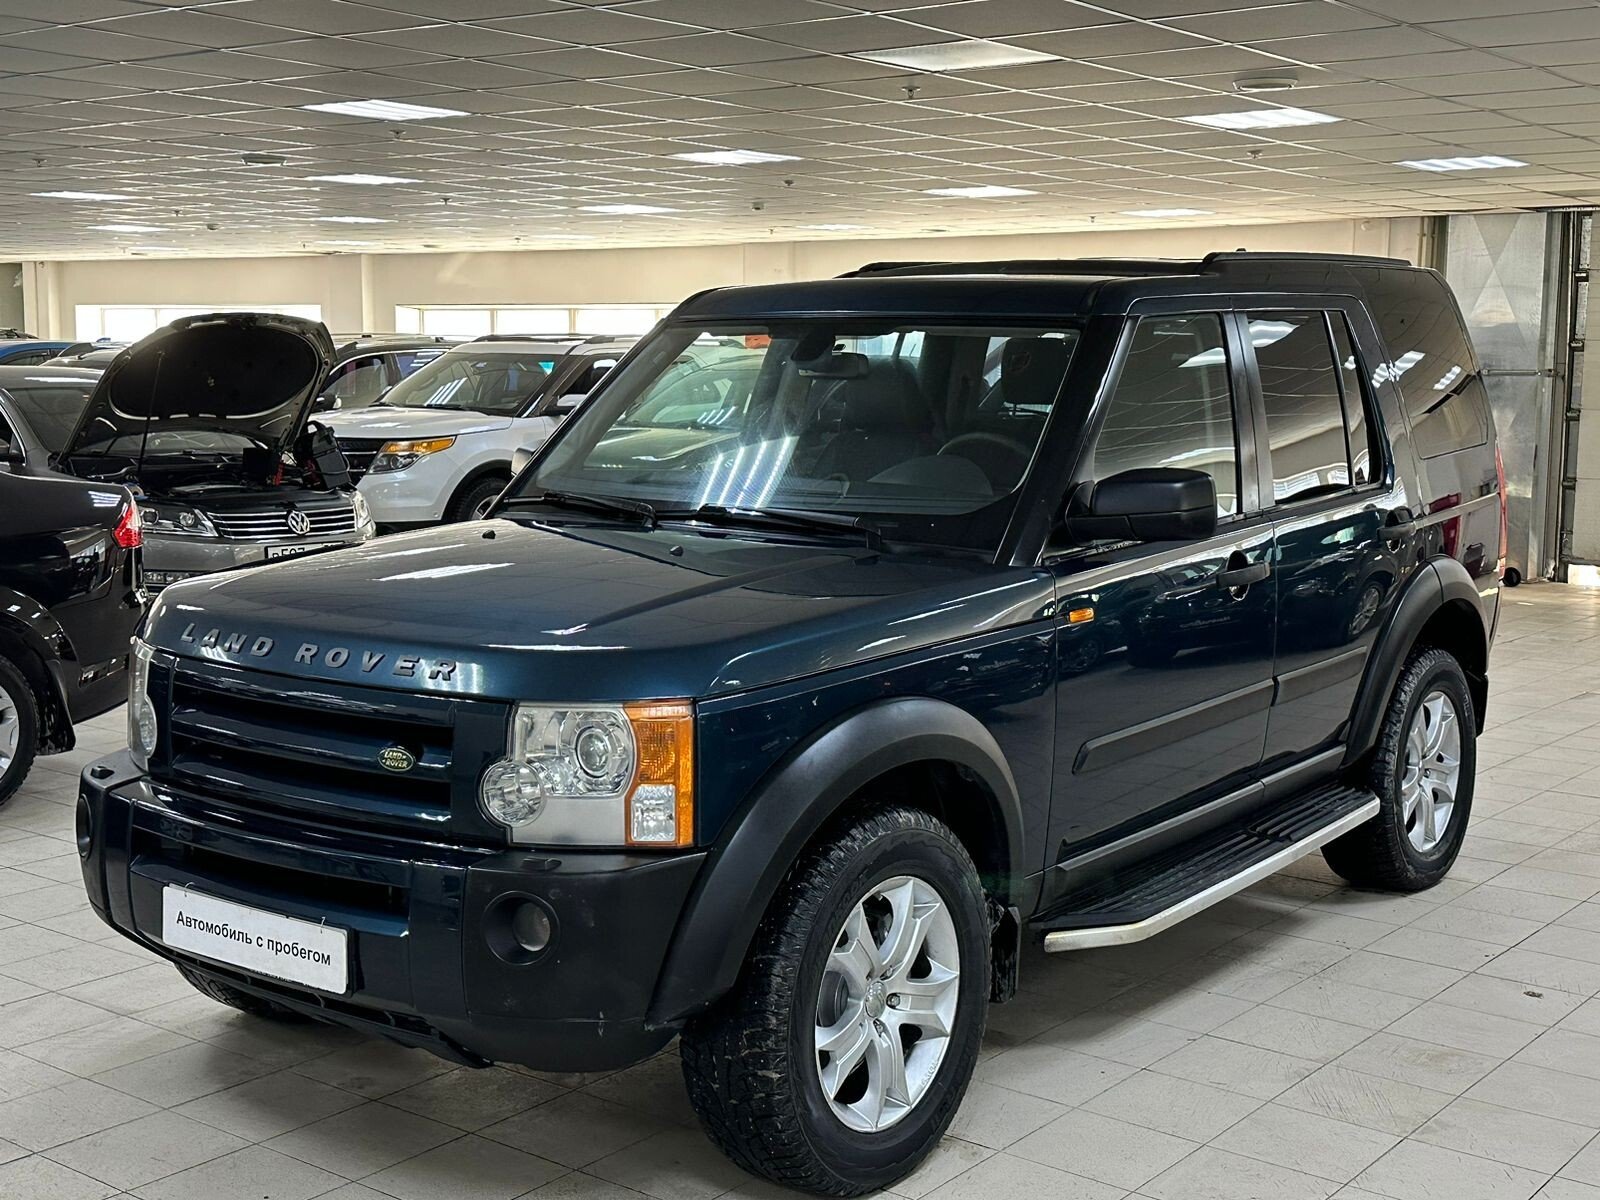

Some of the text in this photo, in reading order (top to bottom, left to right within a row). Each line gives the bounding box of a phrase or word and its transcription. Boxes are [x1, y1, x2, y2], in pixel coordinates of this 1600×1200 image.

[181, 622, 457, 681] LAND ROVER
[384, 751, 403, 760] LAND
[385, 758, 408, 768] ROVER
[176, 910, 331, 966] Автомобиль с пробегом
